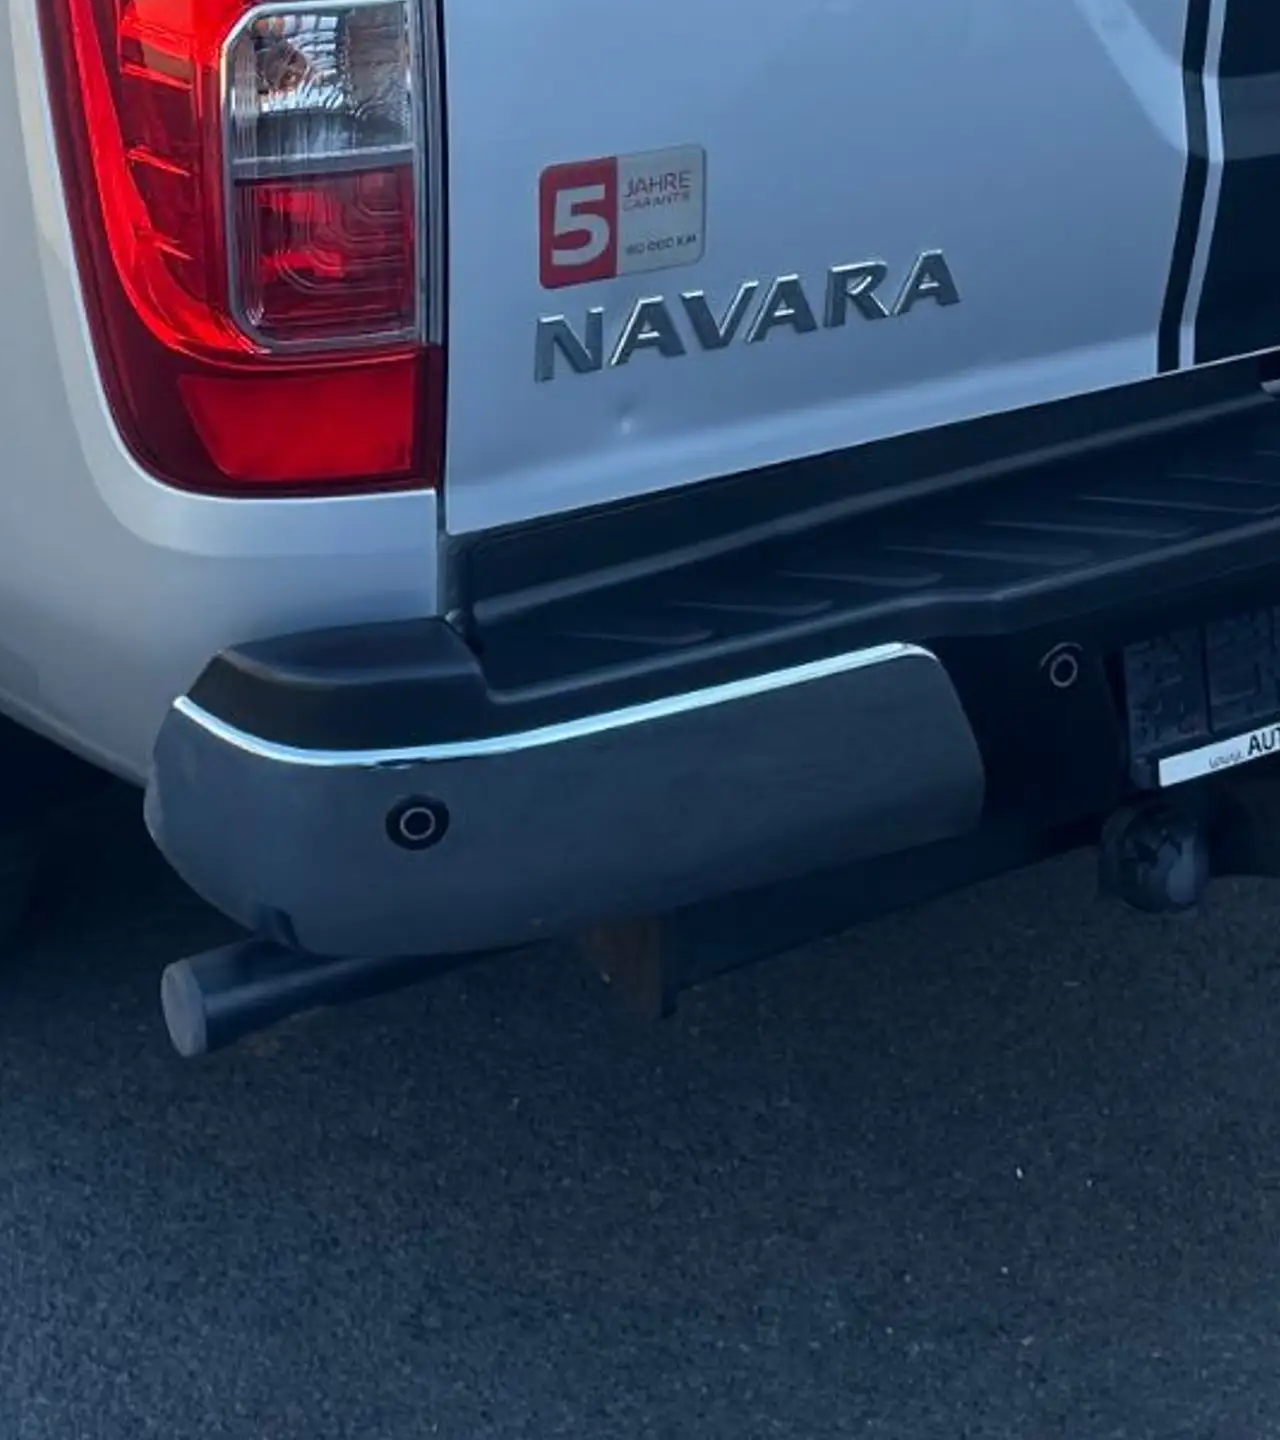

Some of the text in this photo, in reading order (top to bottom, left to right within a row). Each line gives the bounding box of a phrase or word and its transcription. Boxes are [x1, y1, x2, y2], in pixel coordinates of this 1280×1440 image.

[622, 169, 692, 198] JAHRE
[551, 184, 610, 266] 5
[534, 248, 962, 383] NAVARA
